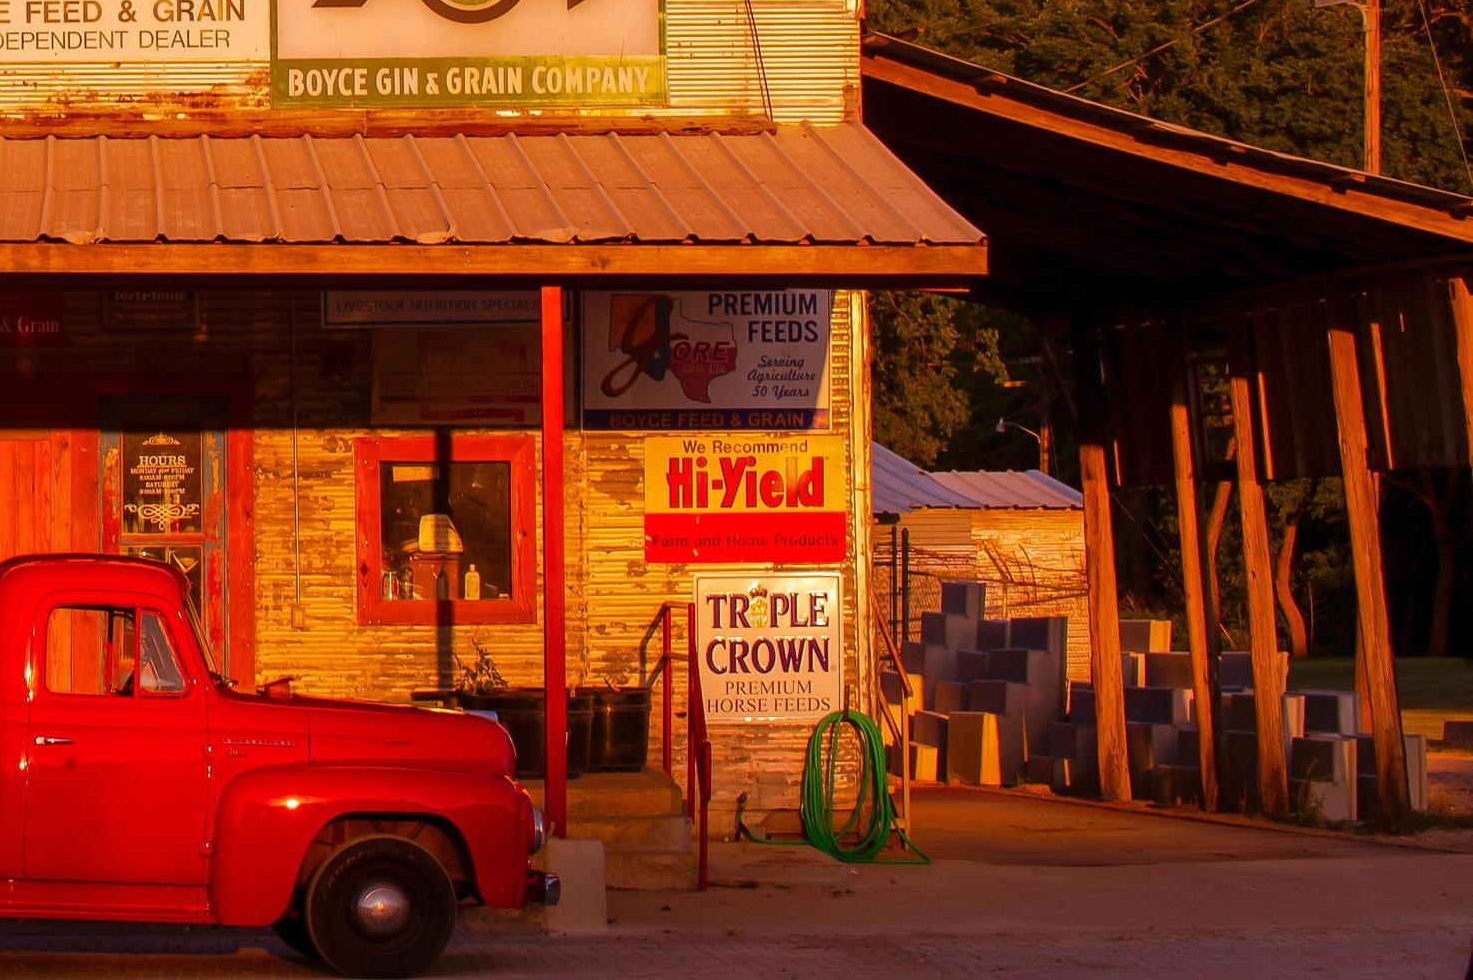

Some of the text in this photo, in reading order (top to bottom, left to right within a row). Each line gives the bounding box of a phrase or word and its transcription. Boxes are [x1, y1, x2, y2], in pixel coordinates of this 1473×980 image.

[25, 0, 103, 23] FEED
[117, 0, 138, 22] &
[139, 29, 230, 49] DEALER
[287, 65, 649, 97] BOYCE GIN & GRAIN COMPANY
[336, 299, 405, 313] LIVESTOCK
[410, 298, 476, 312] NUTRITION
[708, 292, 818, 315] PREMIUM
[0, 316, 12, 334] &
[17, 315, 60, 334] Grain
[748, 320, 819, 343] FEEDS
[757, 355, 805, 370] Serving
[747, 370, 816, 384] Agriculture
[752, 385, 810, 400] 50 Years
[609, 411, 806, 429] BOYCE FEED & GRAIN
[683, 439, 808, 453] We Recommend
[138, 455, 186, 466] HOURS
[666, 456, 825, 508] Hi-Yield
[652, 534, 839, 548] Farm and Home Products
[706, 635, 830, 675] CROWN
[725, 680, 812, 695] PREMIUM
[707, 697, 831, 713] HORSE FEEDS
